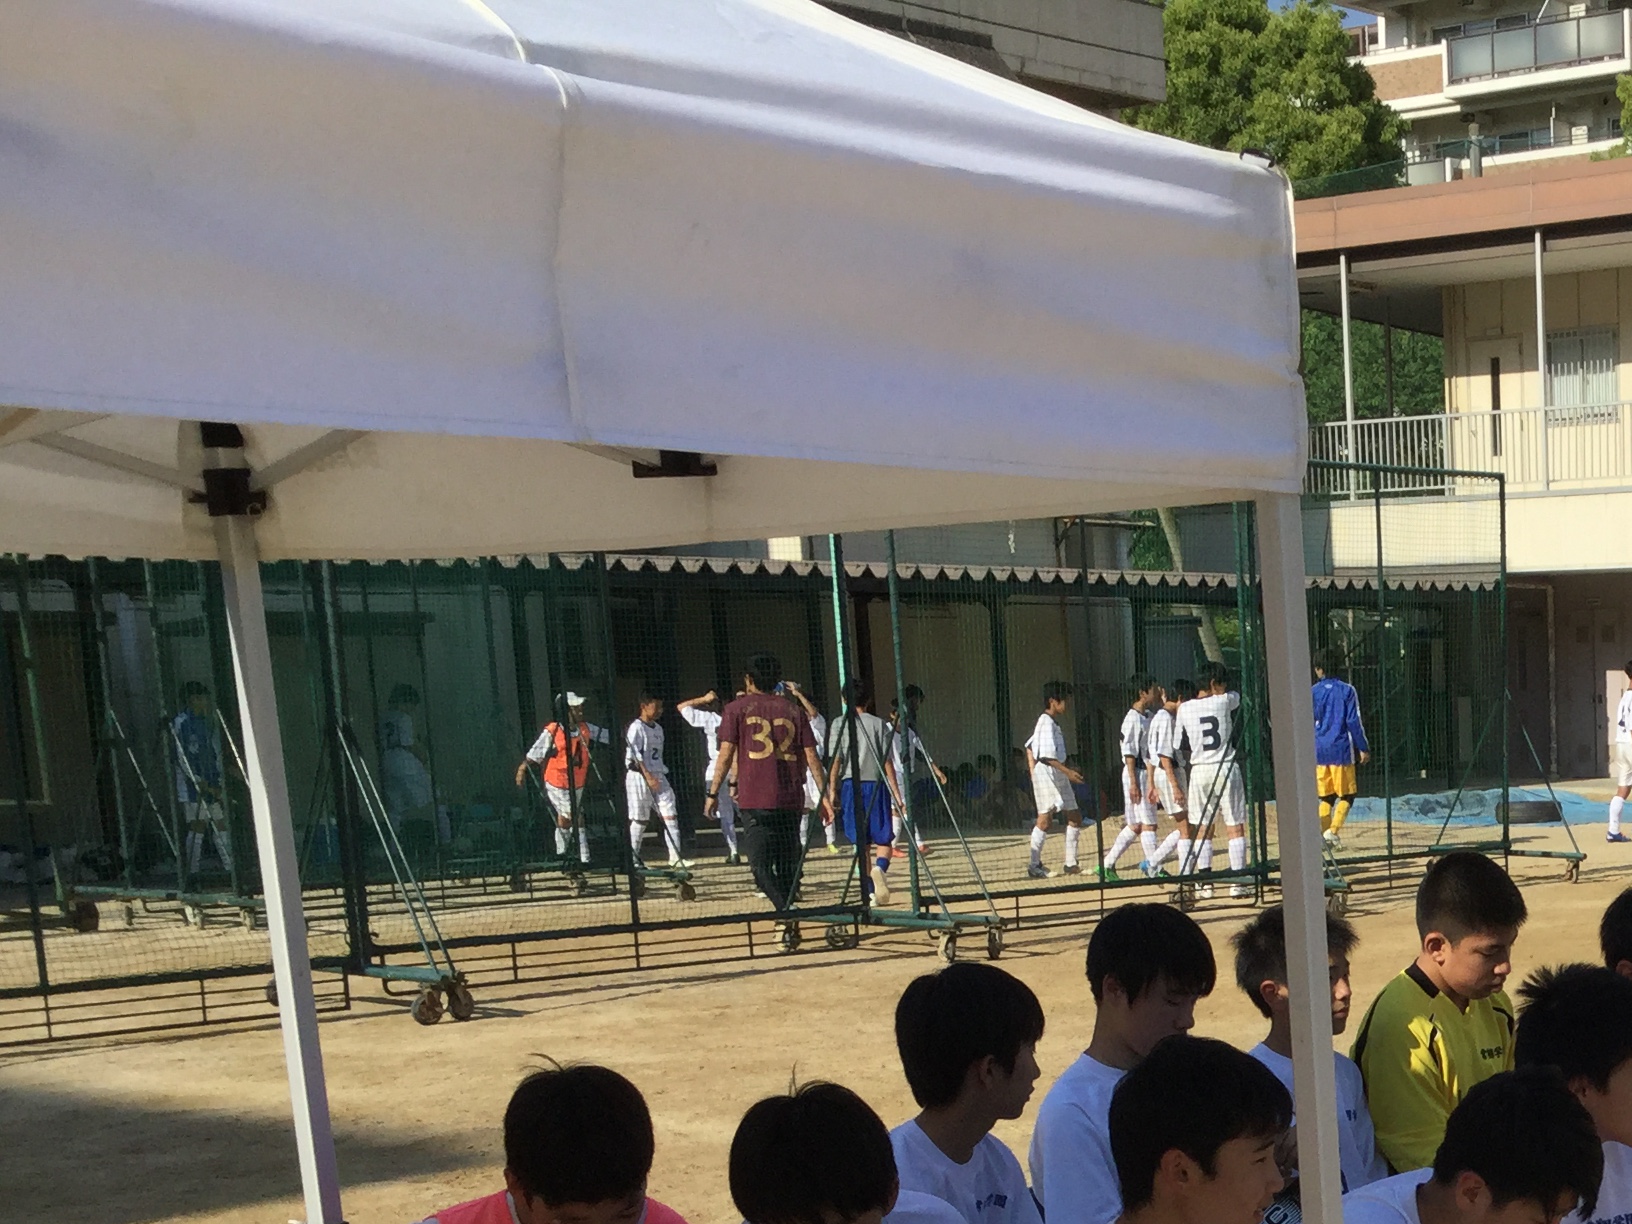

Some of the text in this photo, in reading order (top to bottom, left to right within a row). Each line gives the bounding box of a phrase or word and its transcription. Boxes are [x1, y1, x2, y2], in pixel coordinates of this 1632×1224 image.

[745, 716, 797, 762] 32
[1199, 715, 1221, 751] 3
[651, 747, 660, 761] 2
